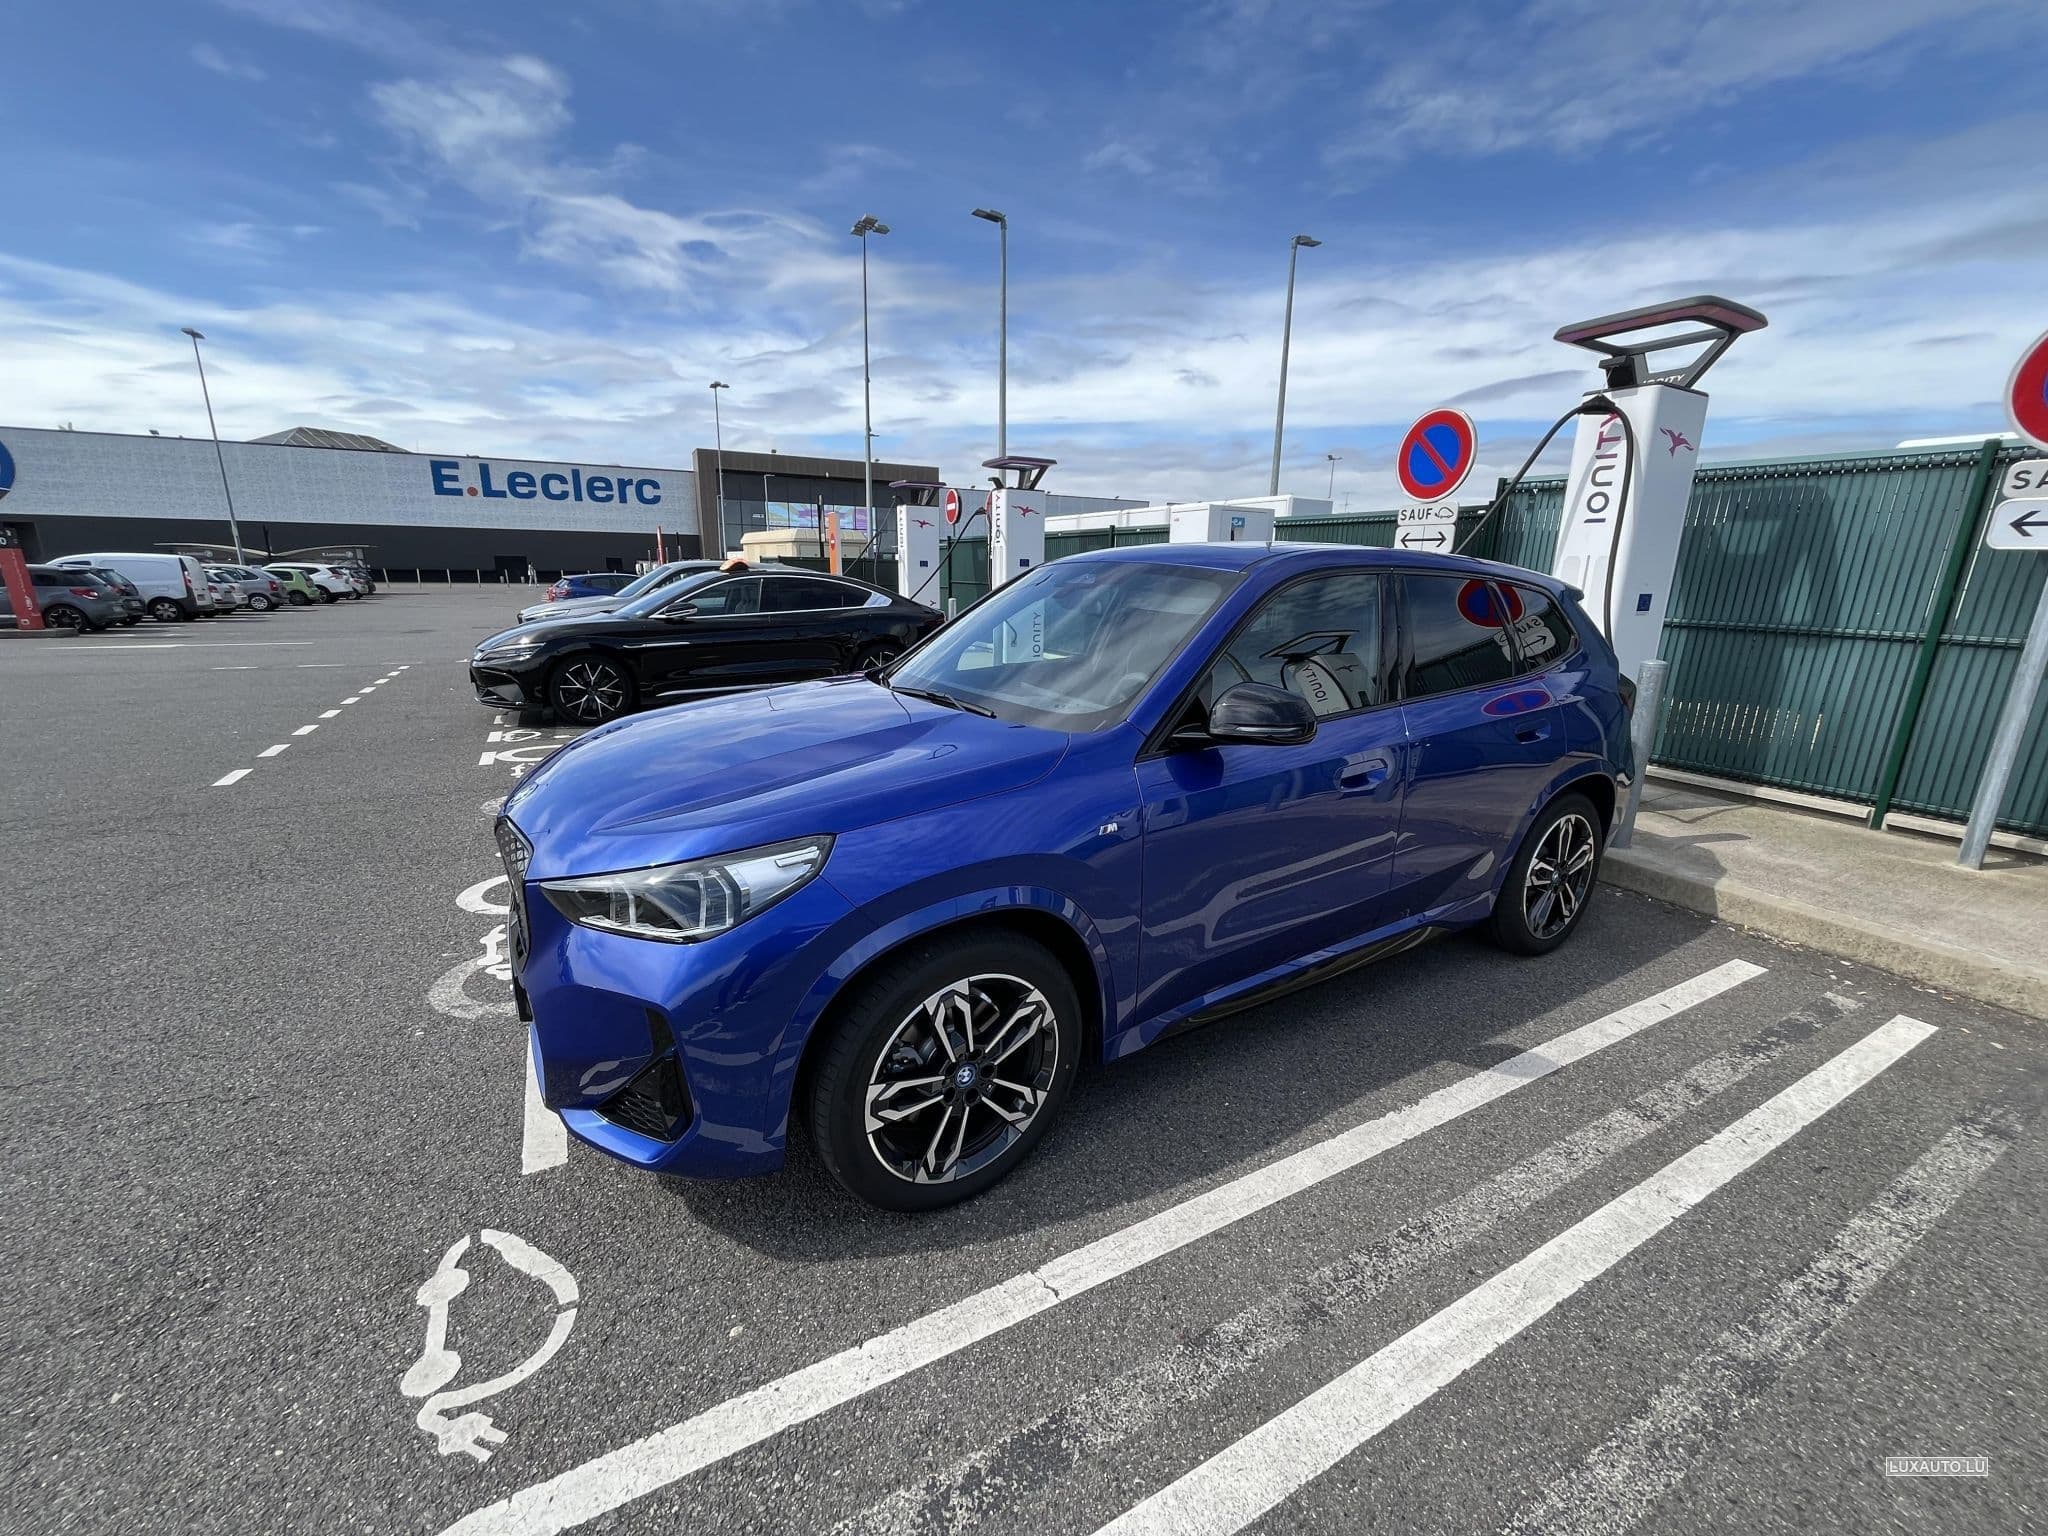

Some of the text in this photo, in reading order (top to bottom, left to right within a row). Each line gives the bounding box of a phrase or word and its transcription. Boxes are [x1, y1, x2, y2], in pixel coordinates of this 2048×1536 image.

[430, 460, 661, 505] E.Leclerc
[1400, 508, 1433, 520] SAUF
[1032, 612, 1041, 657] IONITY
